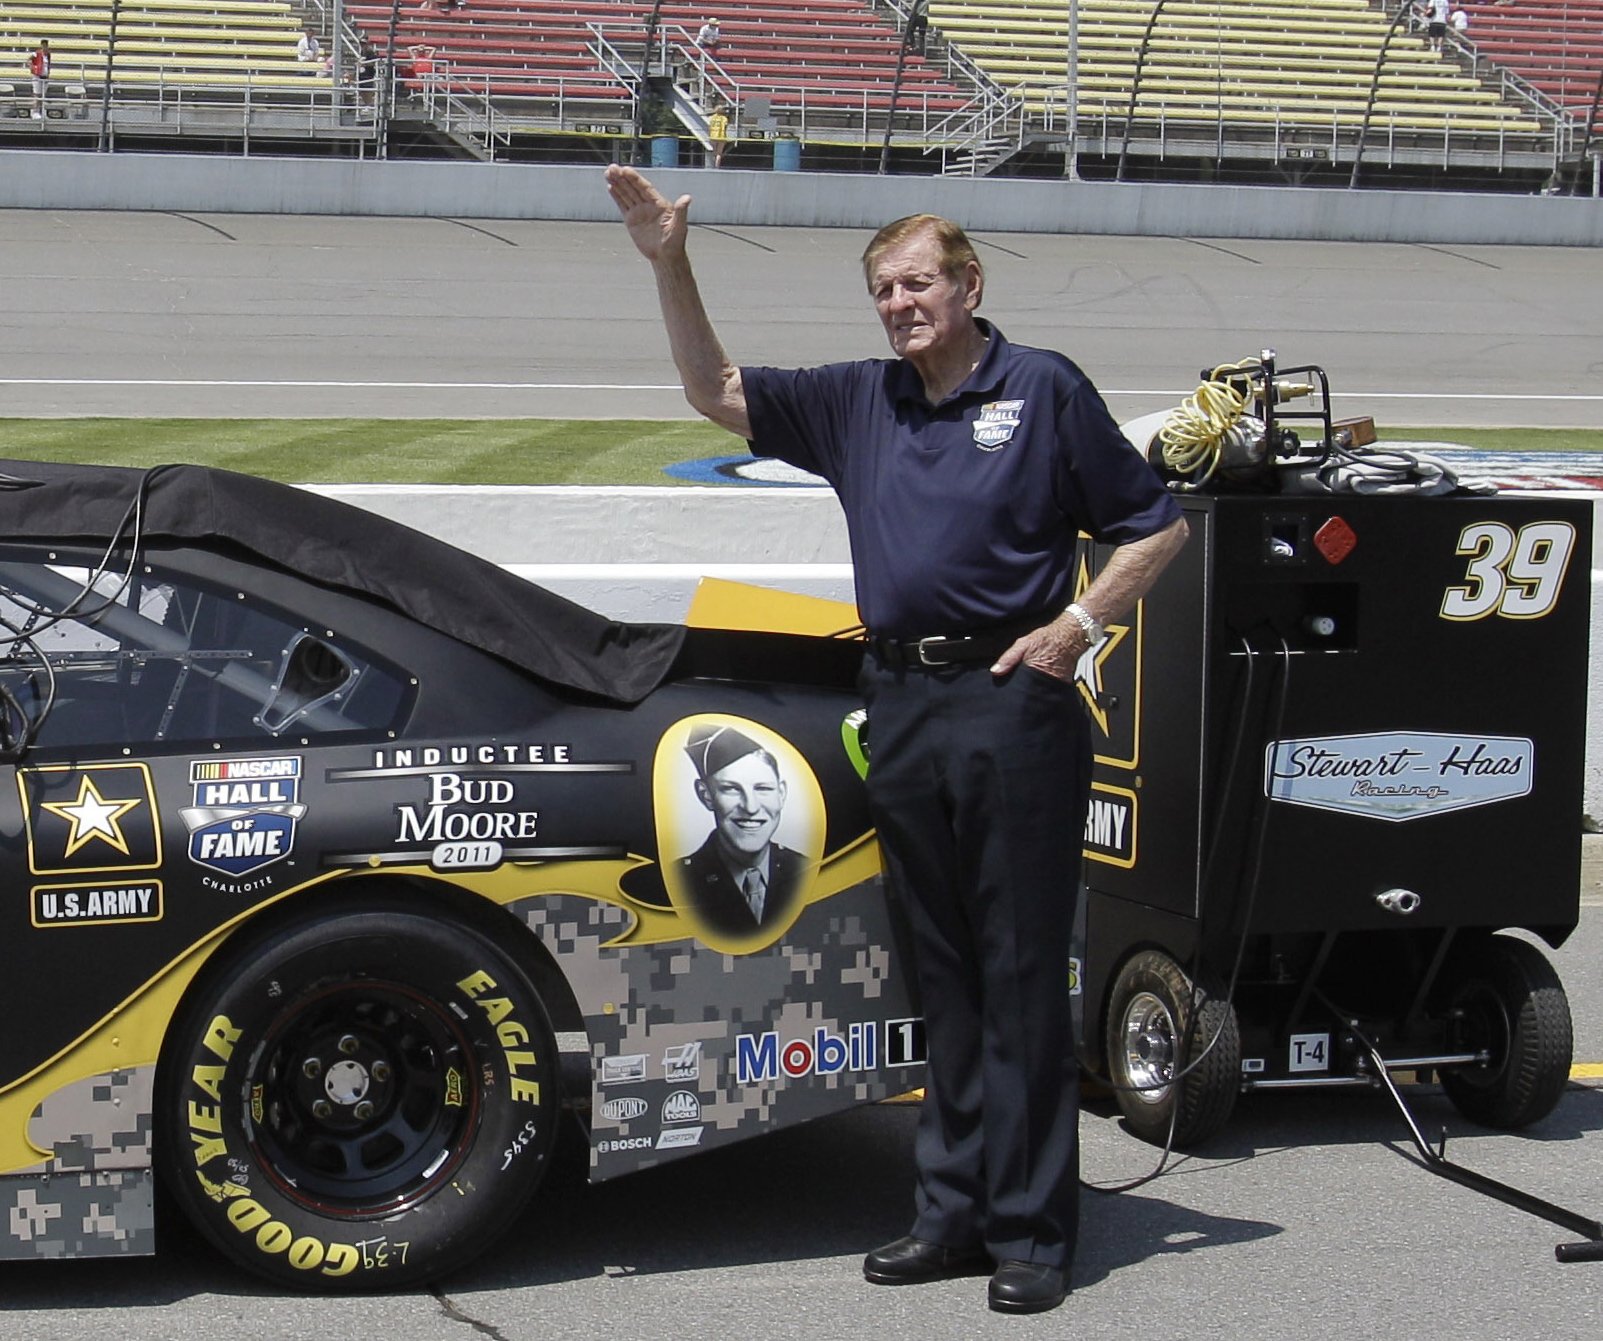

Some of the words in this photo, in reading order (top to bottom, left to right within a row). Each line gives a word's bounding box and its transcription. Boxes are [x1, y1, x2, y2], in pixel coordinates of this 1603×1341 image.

[985, 411, 1013, 421] HALL
[978, 429, 1009, 440] FAME
[1438, 521, 1576, 622] 39
[376, 745, 569, 768] INDUCTEE
[1273, 745, 1423, 779] Stewart
[1439, 743, 1524, 776] Haas
[228, 760, 292, 778] NASCAR
[206, 782, 287, 805] HALL
[1350, 780, 1449, 799] Racing
[232, 819, 255, 831] OF
[1083, 799, 1127, 850] RMY
[200, 830, 283, 859] FAME
[442, 846, 491, 864] 2011
[202, 876, 273, 893] CHARLOTTE
[42, 888, 152, 919] U.S.ARMY
[456, 969, 540, 1107] EAGLE
[736, 1021, 877, 1084] Mobil
[899, 1023, 912, 1061] 1
[1293, 1040, 1324, 1065] T-4
[188, 1014, 243, 1166] YEAR
[449, 1074, 459, 1101] AERO
[664, 1093, 697, 1112] MAC
[665, 1110, 697, 1120] TOOLS
[610, 1137, 652, 1151] BOSCH
[227, 1198, 359, 1277] GOOD
